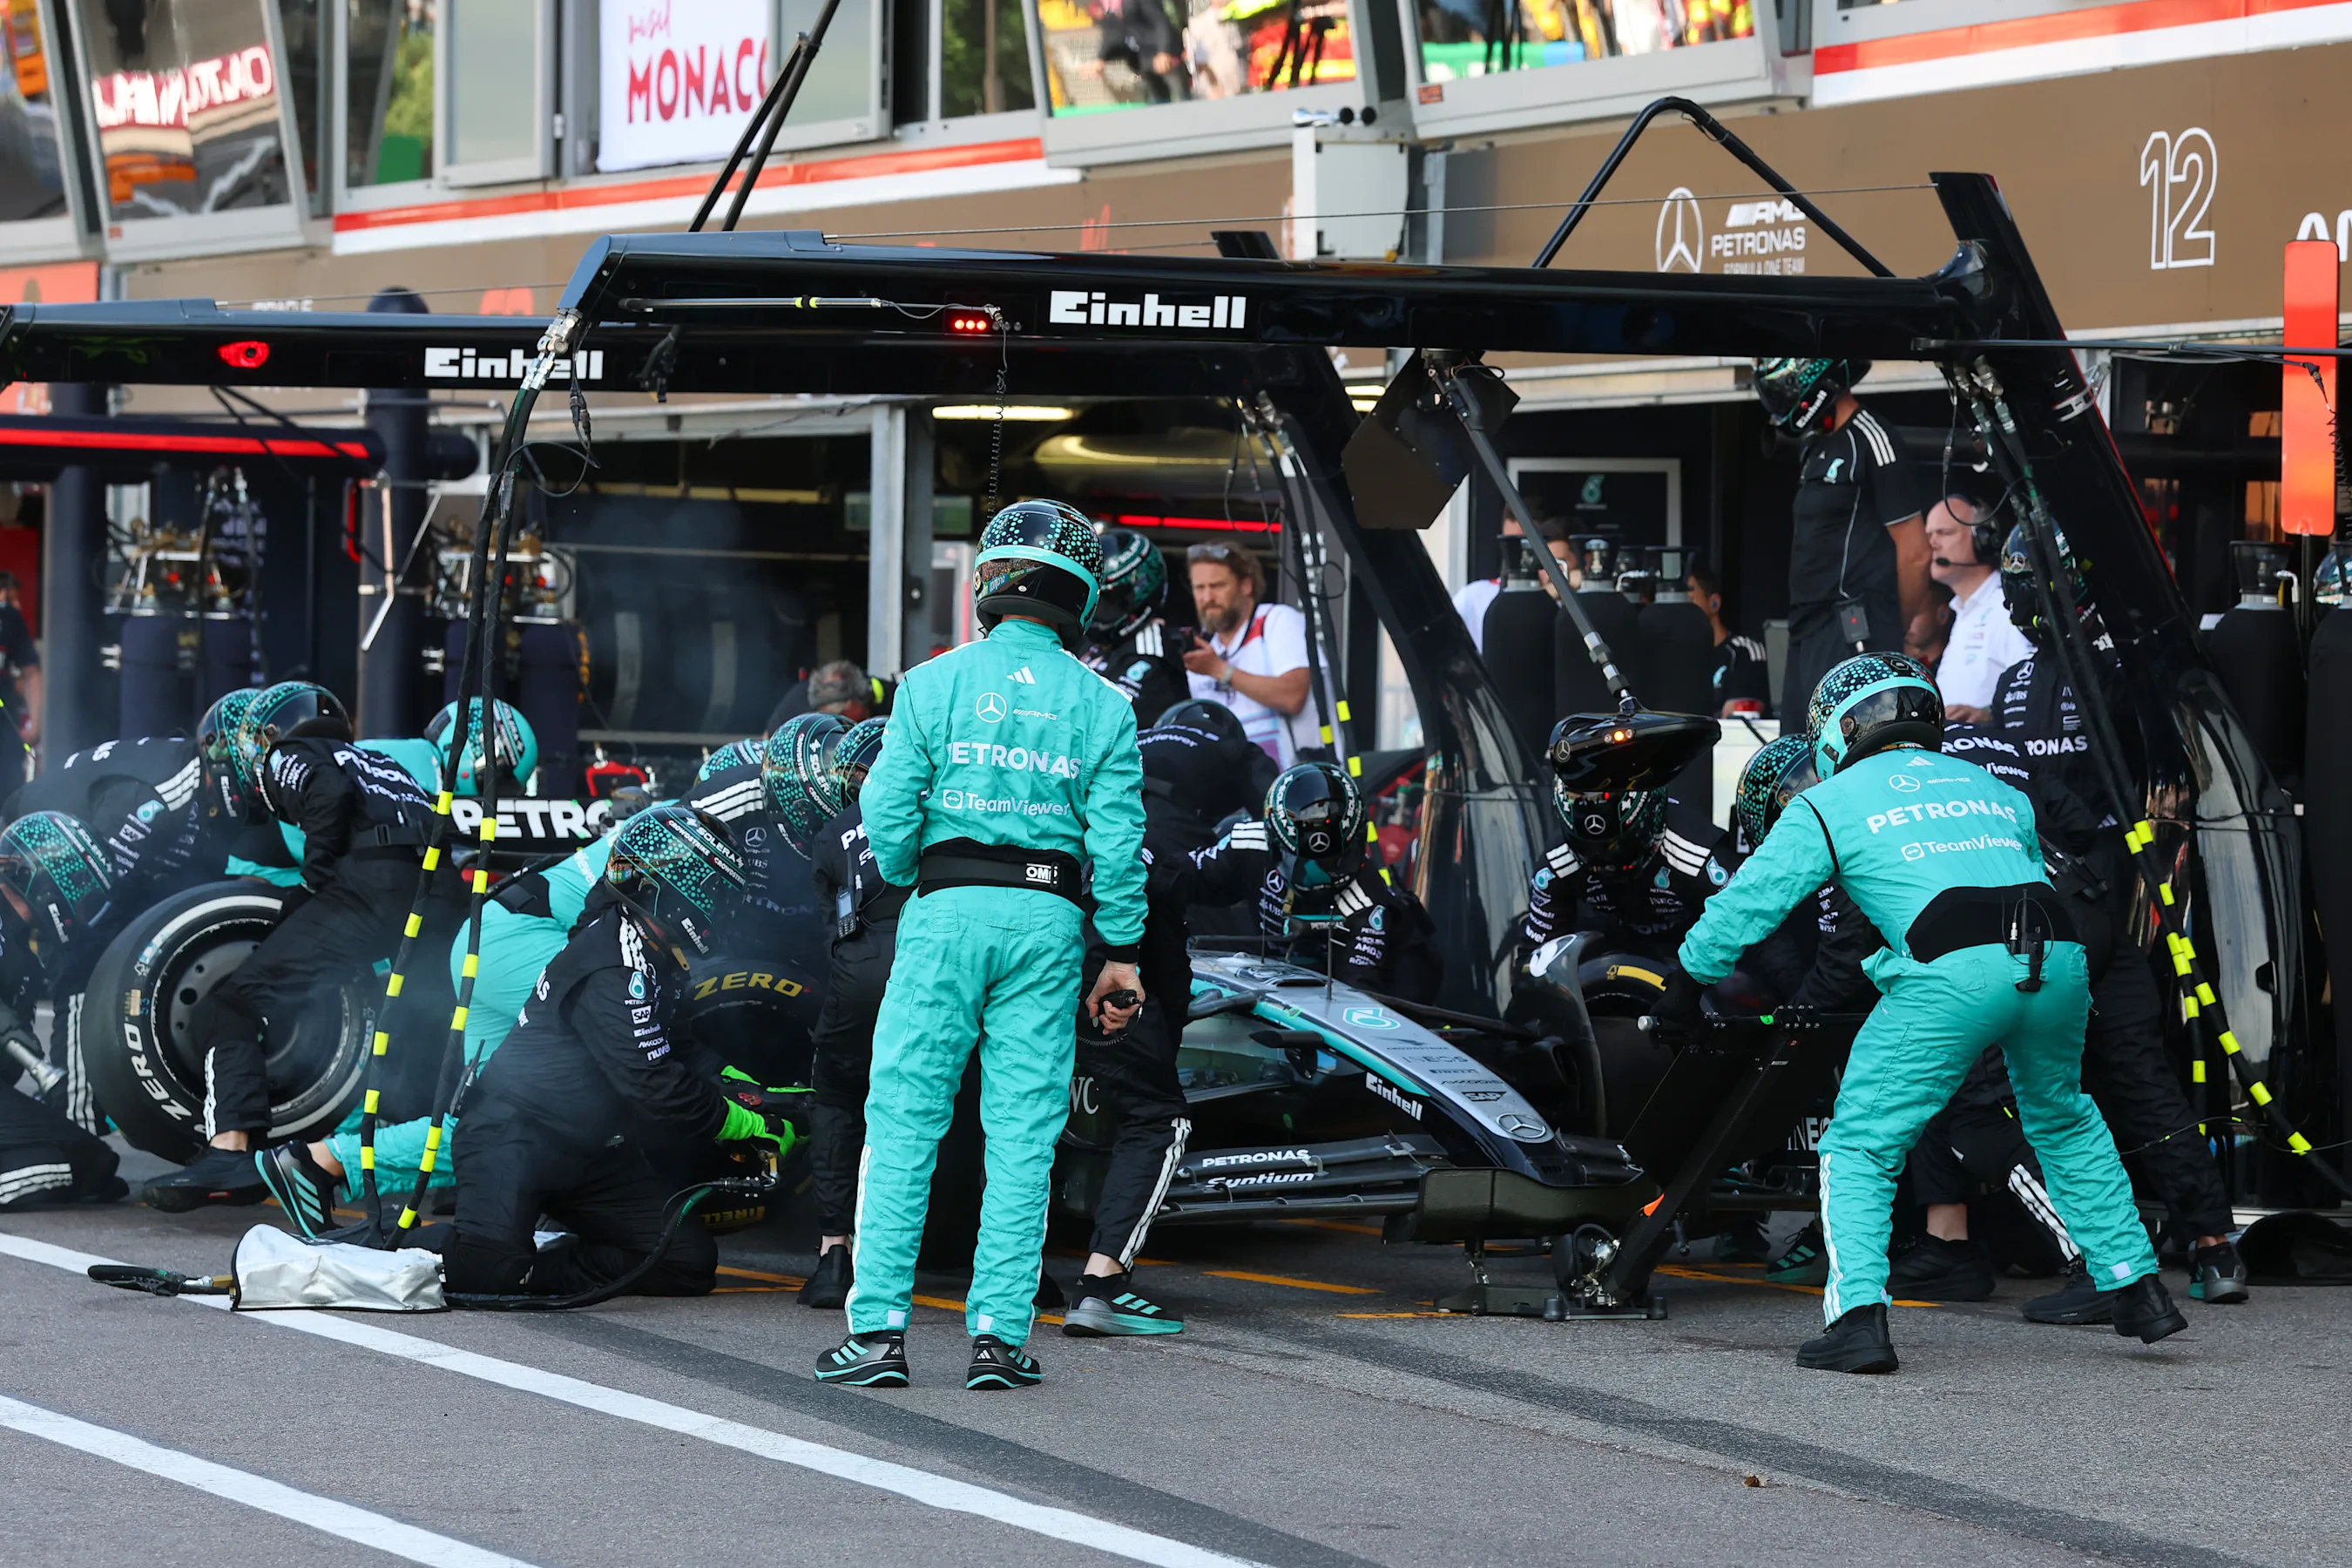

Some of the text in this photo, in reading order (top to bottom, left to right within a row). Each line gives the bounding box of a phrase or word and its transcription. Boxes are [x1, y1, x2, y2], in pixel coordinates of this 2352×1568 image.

[2140, 127, 2218, 269] 12
[1711, 226, 1806, 258] PETRONAS
[1050, 290, 1247, 328] Einhell
[424, 348, 604, 380] Einhell
[1019, 709, 1058, 721] AMG
[965, 792, 1071, 817] TeamViewer
[1866, 799, 2017, 835] PETRONAS
[668, 820, 711, 856] CROWDSTRIKE
[696, 827, 737, 862] SOLERA
[1922, 833, 2024, 854] TeamViewer
[681, 916, 709, 954] Einhell
[693, 971, 803, 1001] ZERO
[124, 1022, 193, 1121] ZERO
[1365, 1071, 1423, 1121] Einhell
[1469, 1092, 1502, 1101] SAP
[1202, 1148, 1310, 1168] PETRONAS
[1205, 1171, 1315, 1189] Syntium
[700, 1206, 766, 1224] PIRELL
